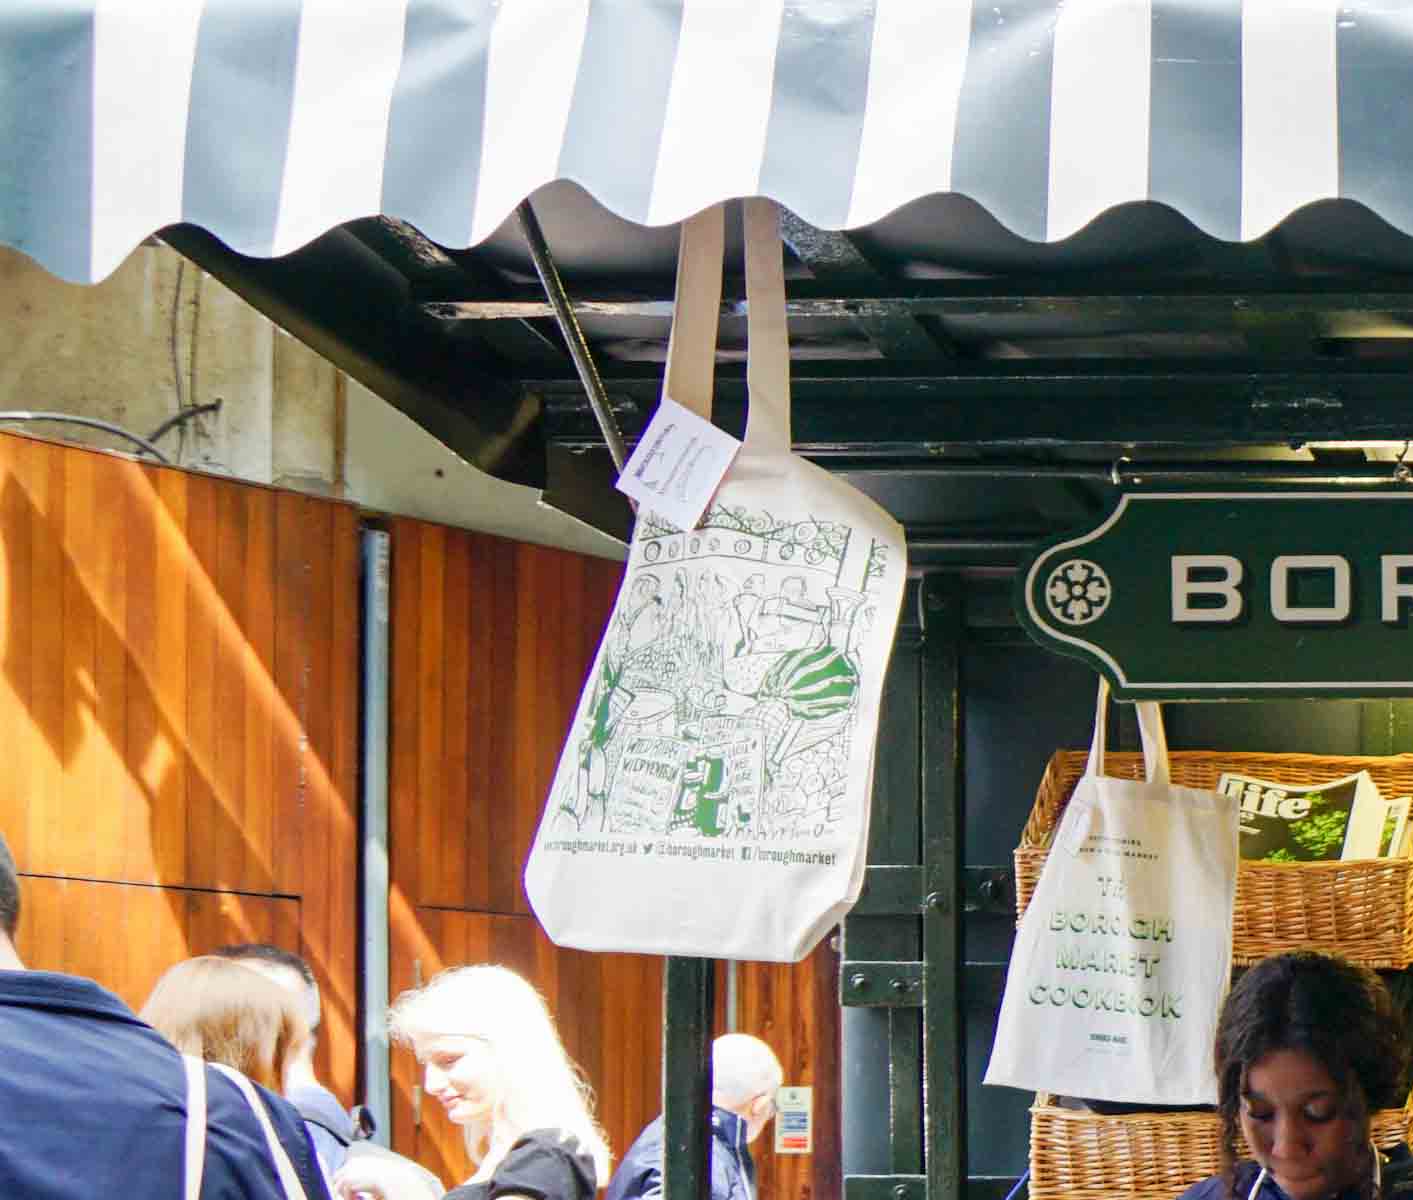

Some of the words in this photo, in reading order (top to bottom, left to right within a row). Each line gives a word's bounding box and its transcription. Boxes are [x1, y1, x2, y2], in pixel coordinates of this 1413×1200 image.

[1050, 911, 1175, 943] BOROGH
[1055, 945, 1161, 979] MARET
[1029, 985, 1184, 1019] COOKBOK
